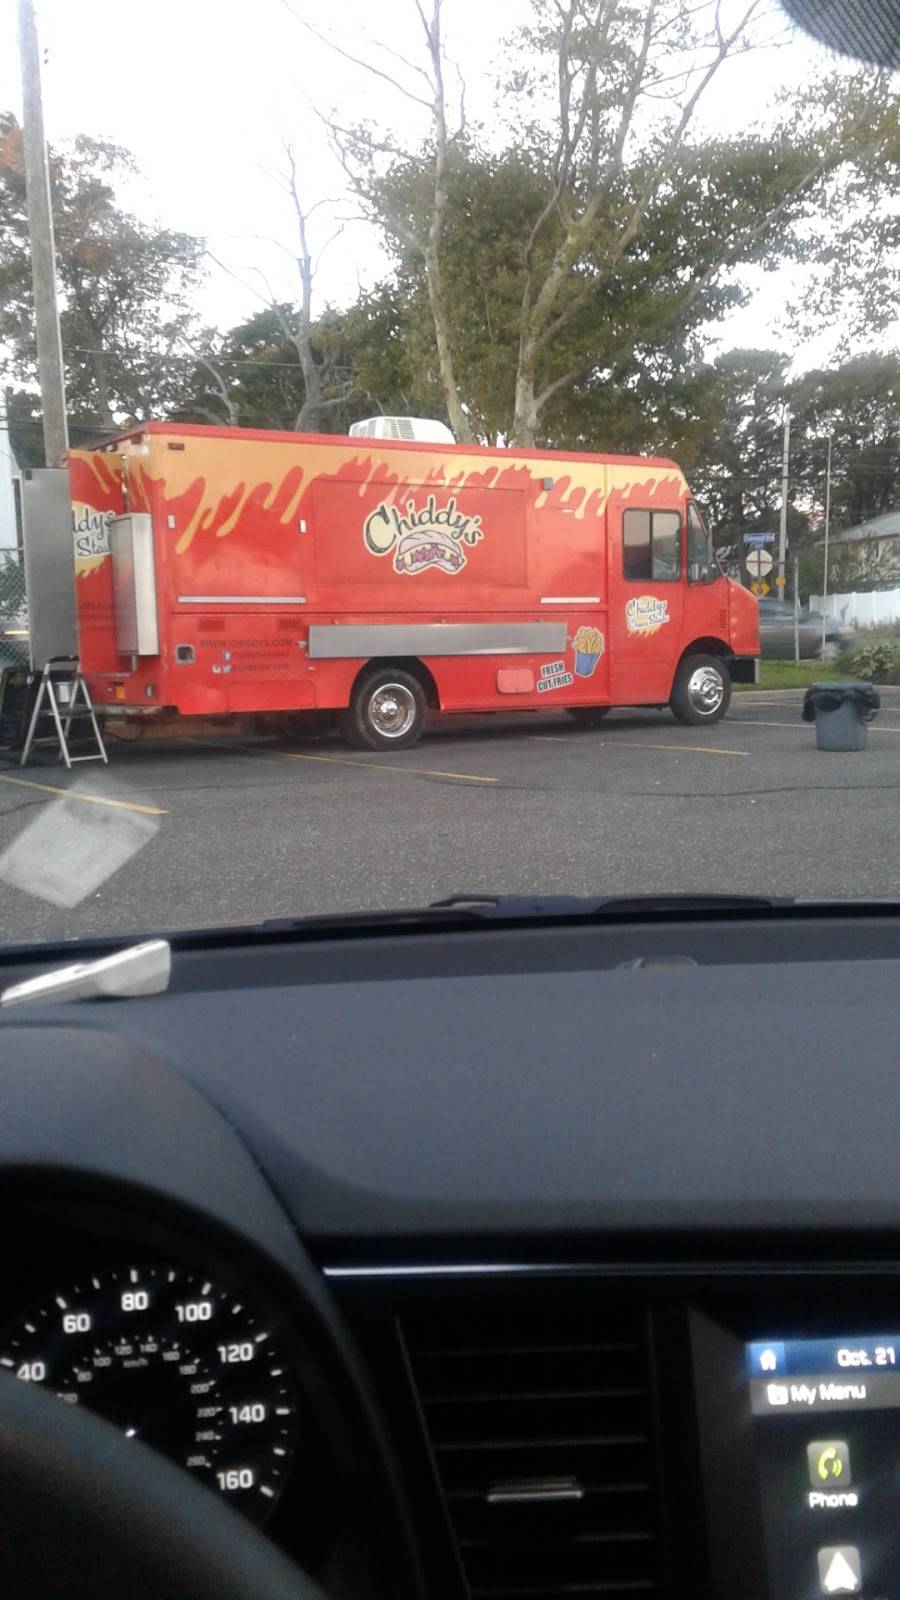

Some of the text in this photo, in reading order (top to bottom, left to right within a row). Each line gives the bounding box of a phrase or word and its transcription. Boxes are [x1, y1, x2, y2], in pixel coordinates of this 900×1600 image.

[364, 496, 482, 554] Chiddy's
[542, 661, 565, 677] FRESH
[538, 673, 573, 691] CUT FRIES
[121, 1291, 149, 1311] 80
[175, 1302, 212, 1322] 100
[62, 1313, 91, 1333] 60
[217, 1343, 254, 1363] 120
[837, 1347, 896, 1367] Oct. 21
[17, 1361, 45, 1382] 40
[790, 1382, 867, 1405] My Menu
[228, 1404, 265, 1424] 140
[216, 1469, 254, 1490] 160
[809, 1491, 858, 1509] Phone
